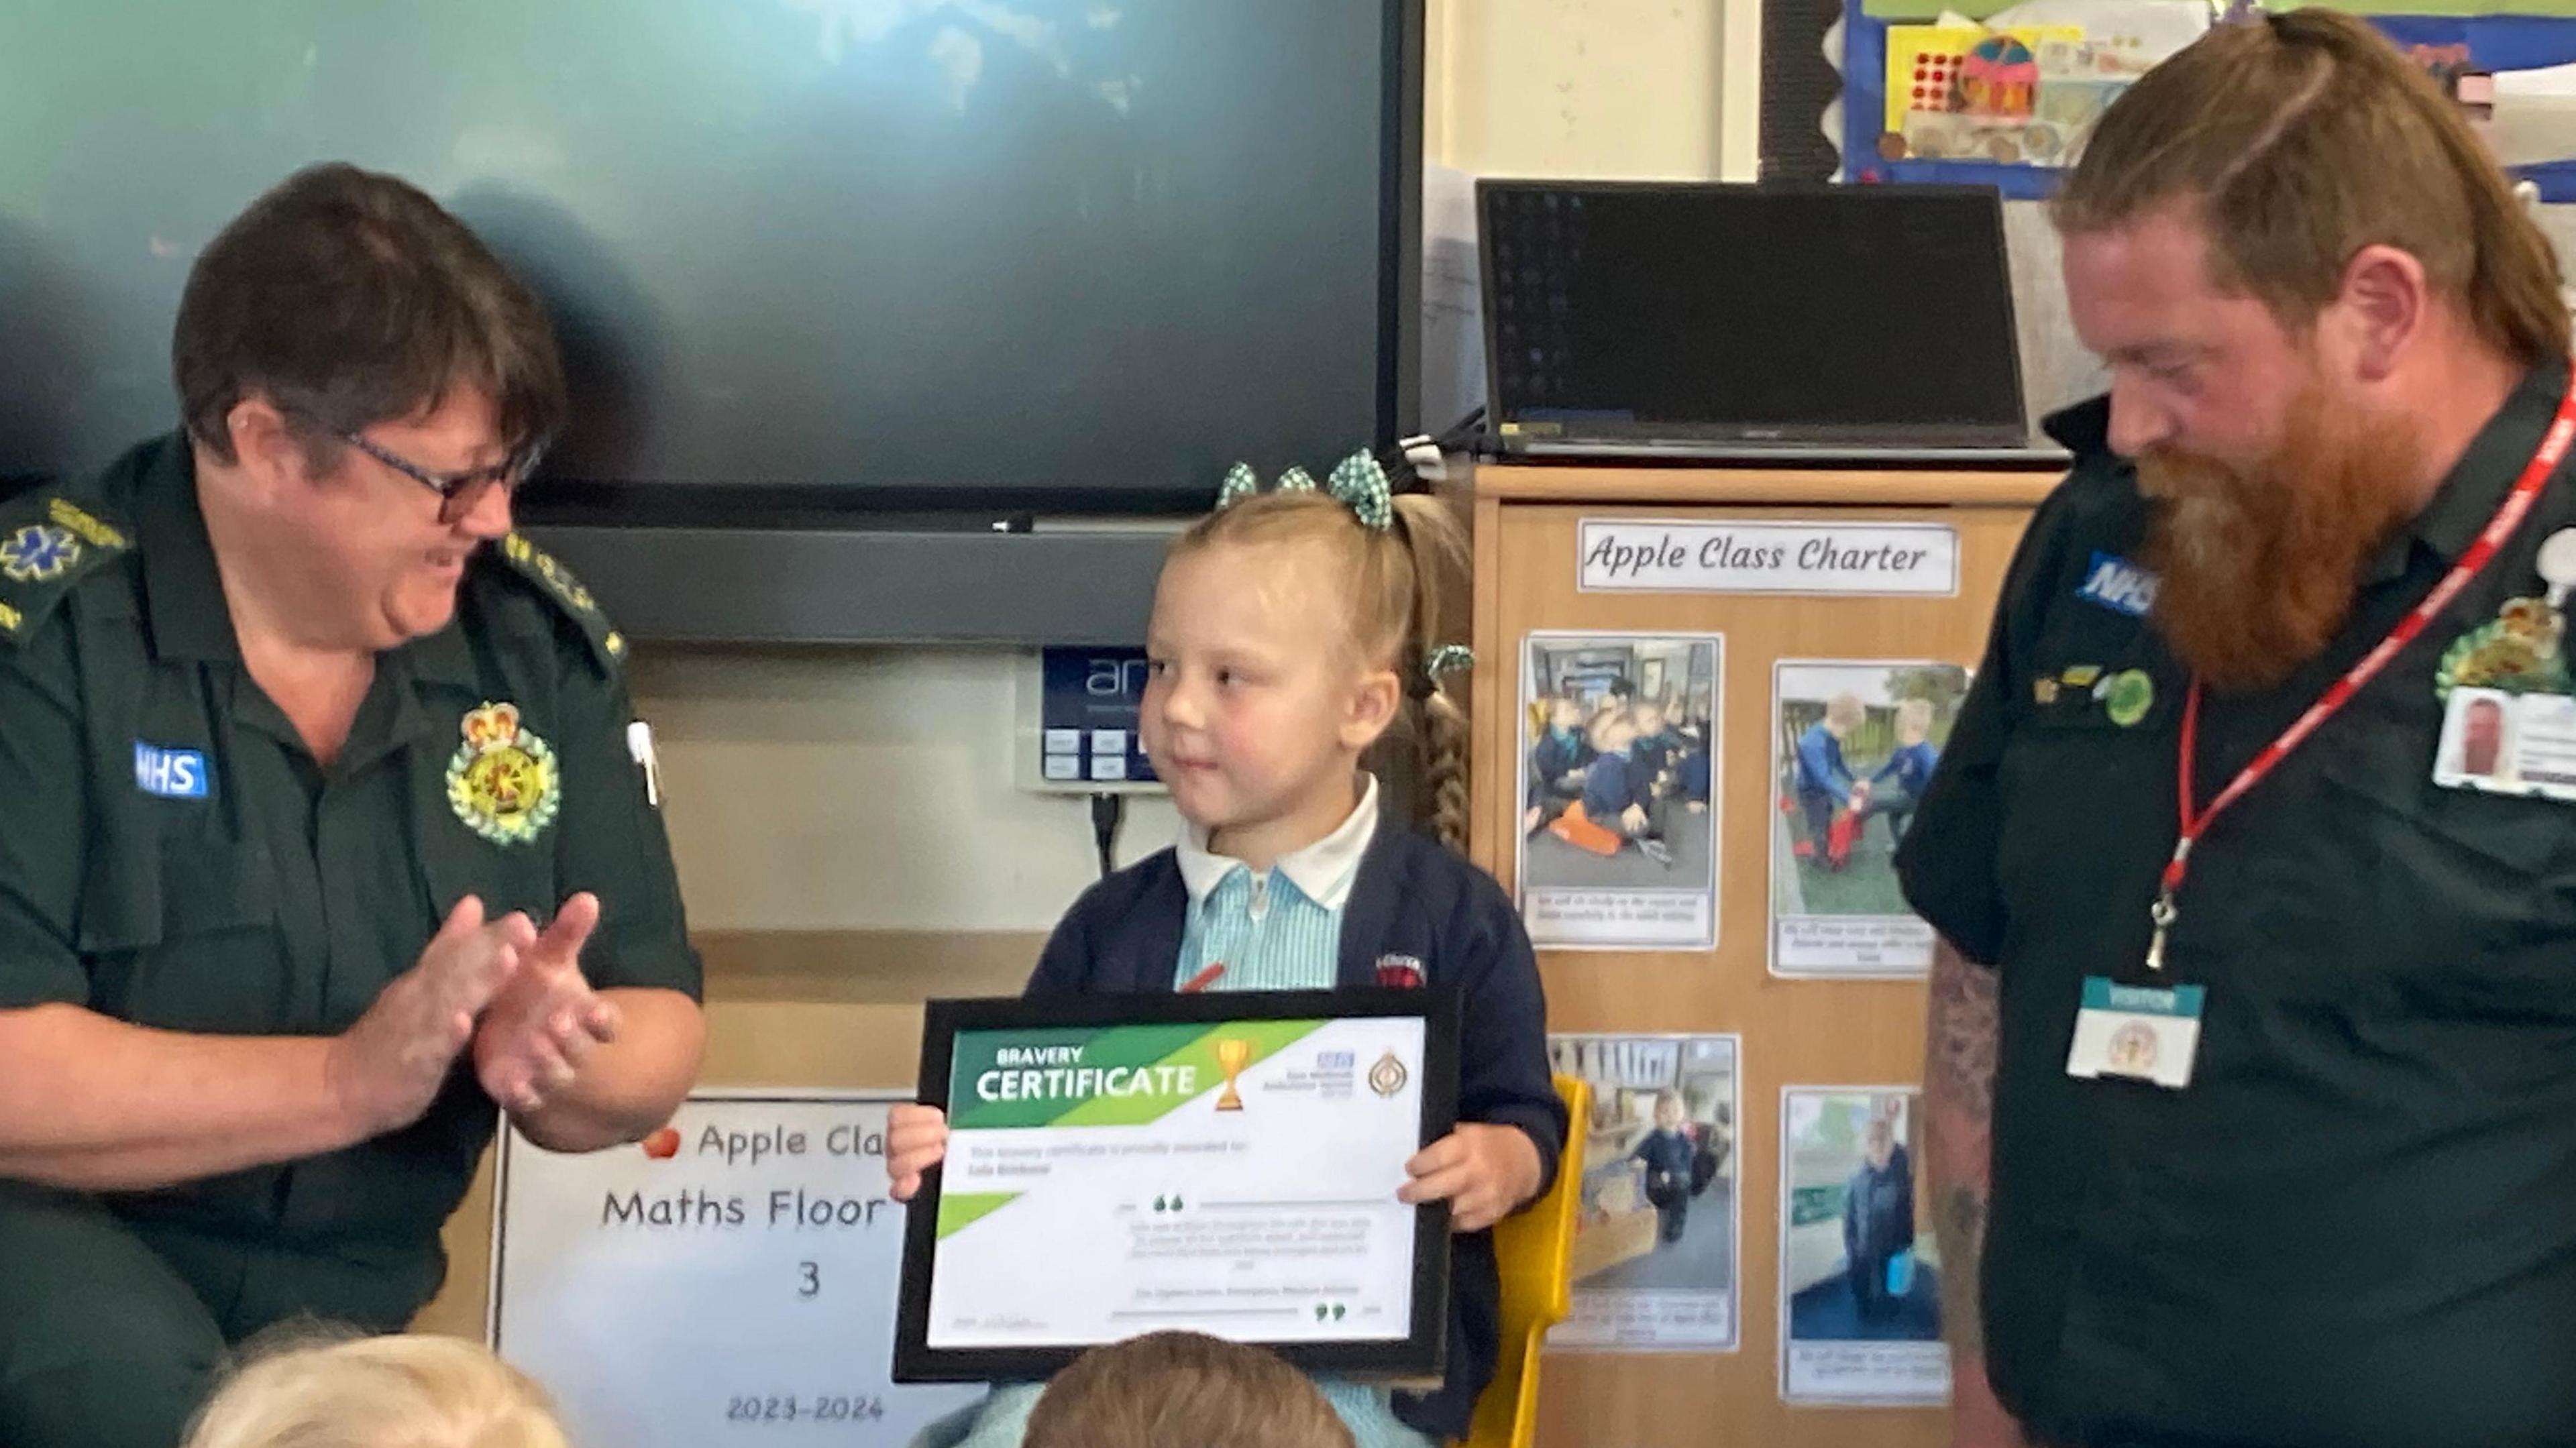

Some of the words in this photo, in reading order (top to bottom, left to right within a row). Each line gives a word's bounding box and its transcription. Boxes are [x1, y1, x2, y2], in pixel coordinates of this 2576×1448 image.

[1585, 535, 1686, 577] Apple
[1699, 536, 1784, 571] Class
[1798, 537, 1927, 571] Charter
[1086, 658, 1146, 695] ar
[136, 741, 197, 793] NHS
[997, 1046, 1083, 1065] BRAVERY
[977, 1066, 1197, 1101] CERTIFICATE
[698, 1125, 806, 1166] Apple
[826, 1125, 885, 1156] Cla
[603, 1188, 745, 1226] Maths
[769, 1187, 888, 1227] Floor
[798, 1261, 820, 1296] 3
[727, 1395, 884, 1422] 2023-2024
